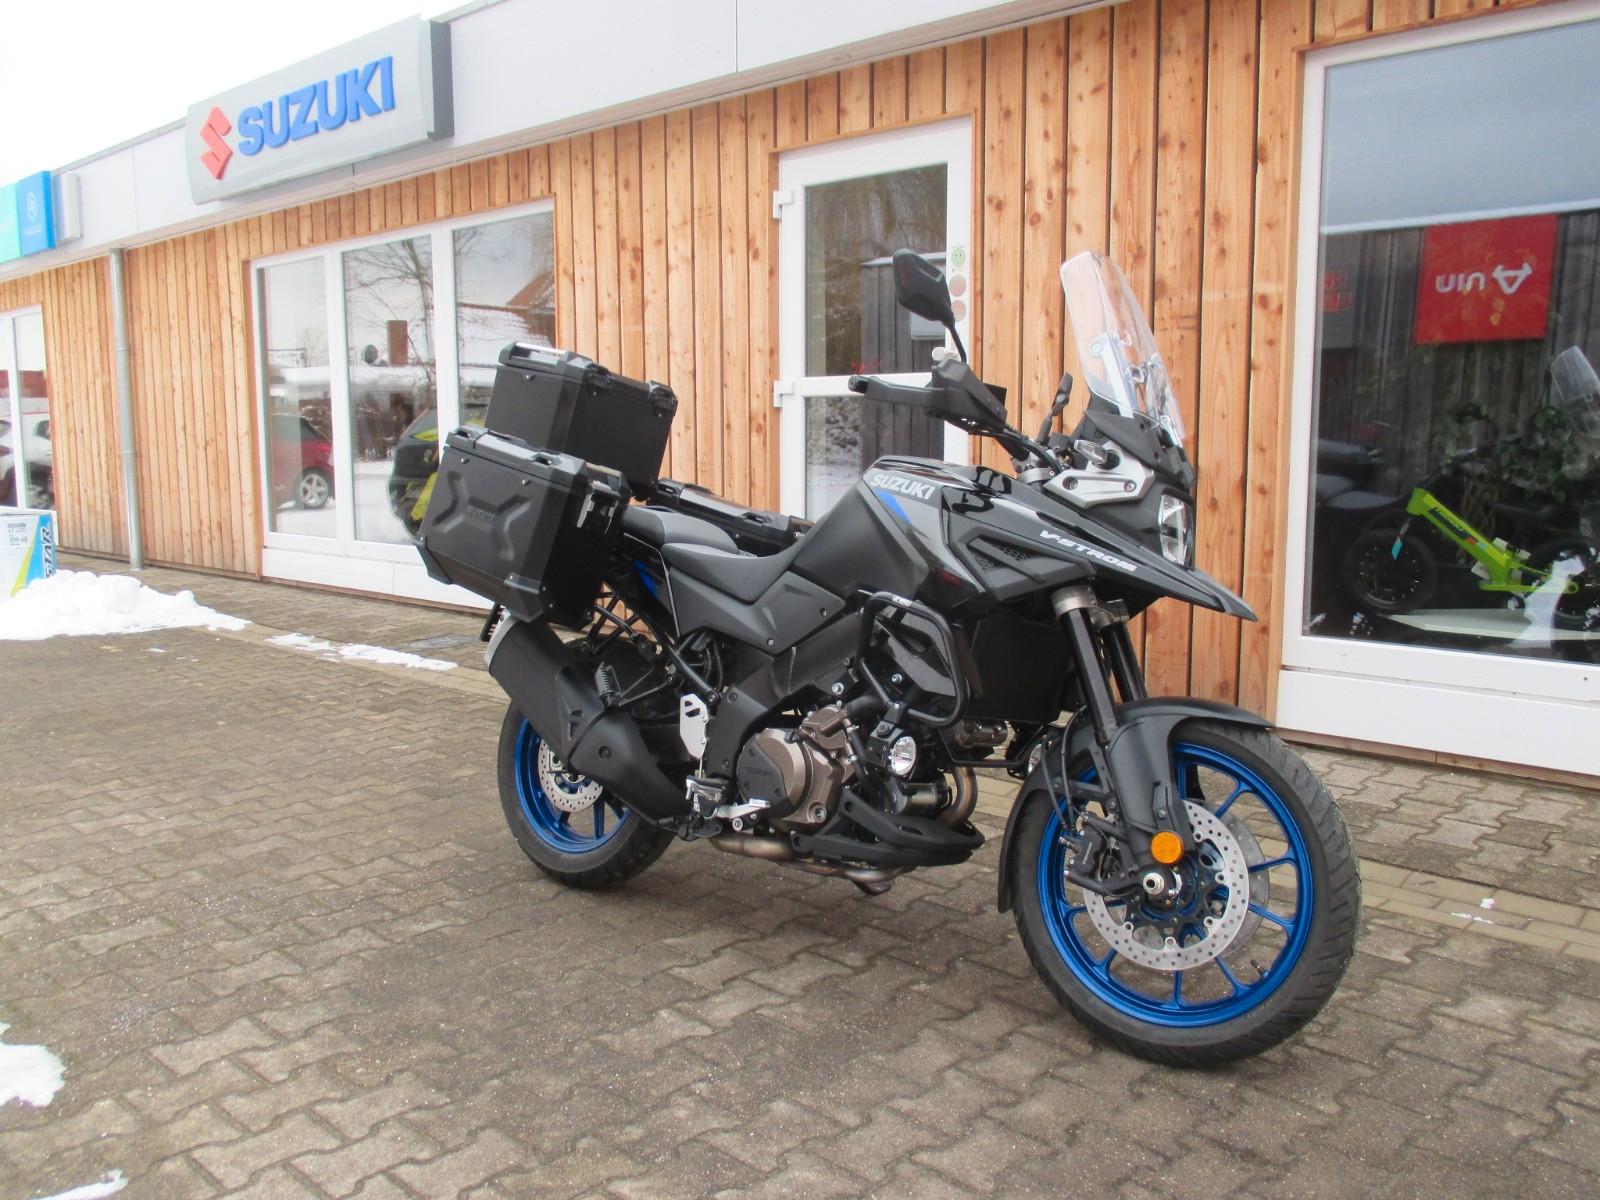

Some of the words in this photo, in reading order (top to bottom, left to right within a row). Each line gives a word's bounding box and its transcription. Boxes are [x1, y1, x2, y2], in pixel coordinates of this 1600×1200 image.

[238, 55, 396, 156] SUZUKI
[869, 473, 936, 501] SUZUKI
[1039, 529, 1138, 573] V-STROM
